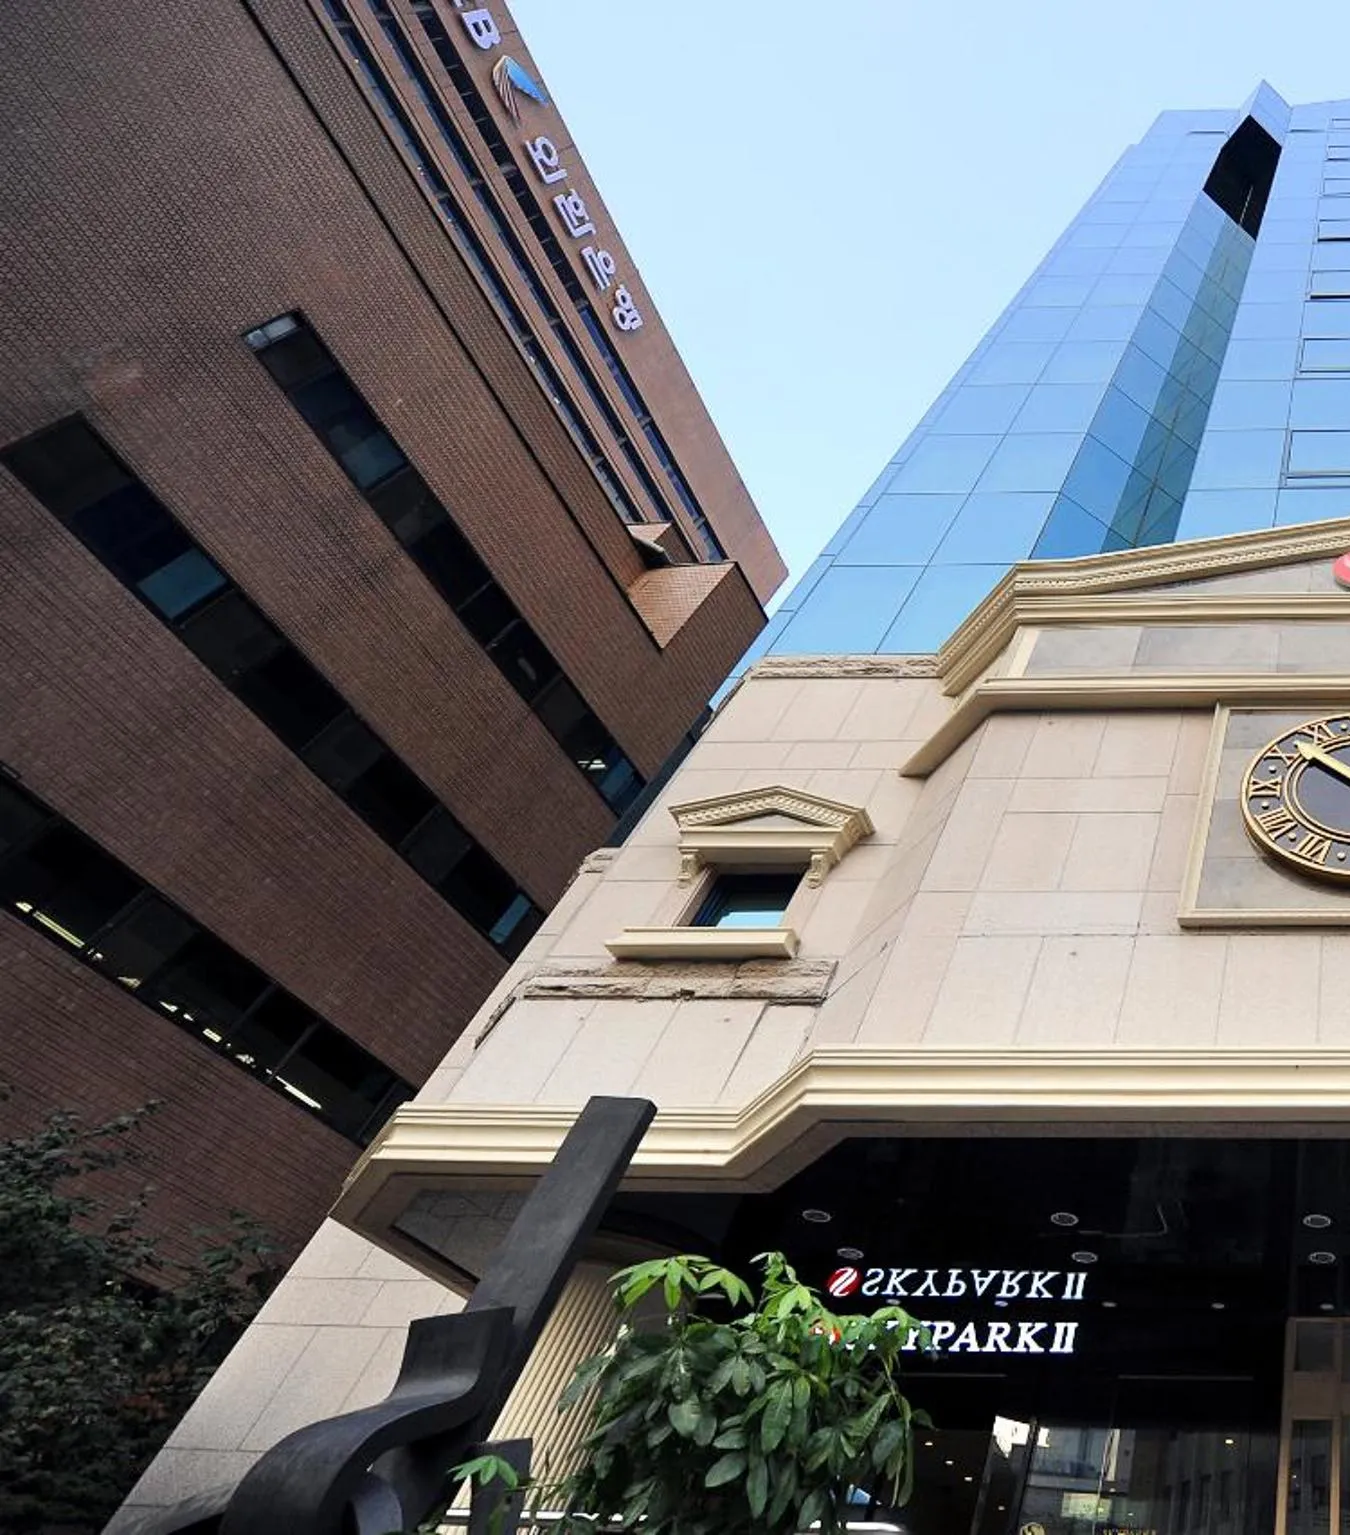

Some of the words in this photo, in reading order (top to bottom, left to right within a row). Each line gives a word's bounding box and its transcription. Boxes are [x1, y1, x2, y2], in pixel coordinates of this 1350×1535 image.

[524, 136, 643, 332] 외환은행
[1297, 721, 1341, 742] XI
[1264, 745, 1297, 767] X
[1250, 776, 1282, 798] IX
[1253, 806, 1298, 840] VIII
[1289, 831, 1332, 865] VII
